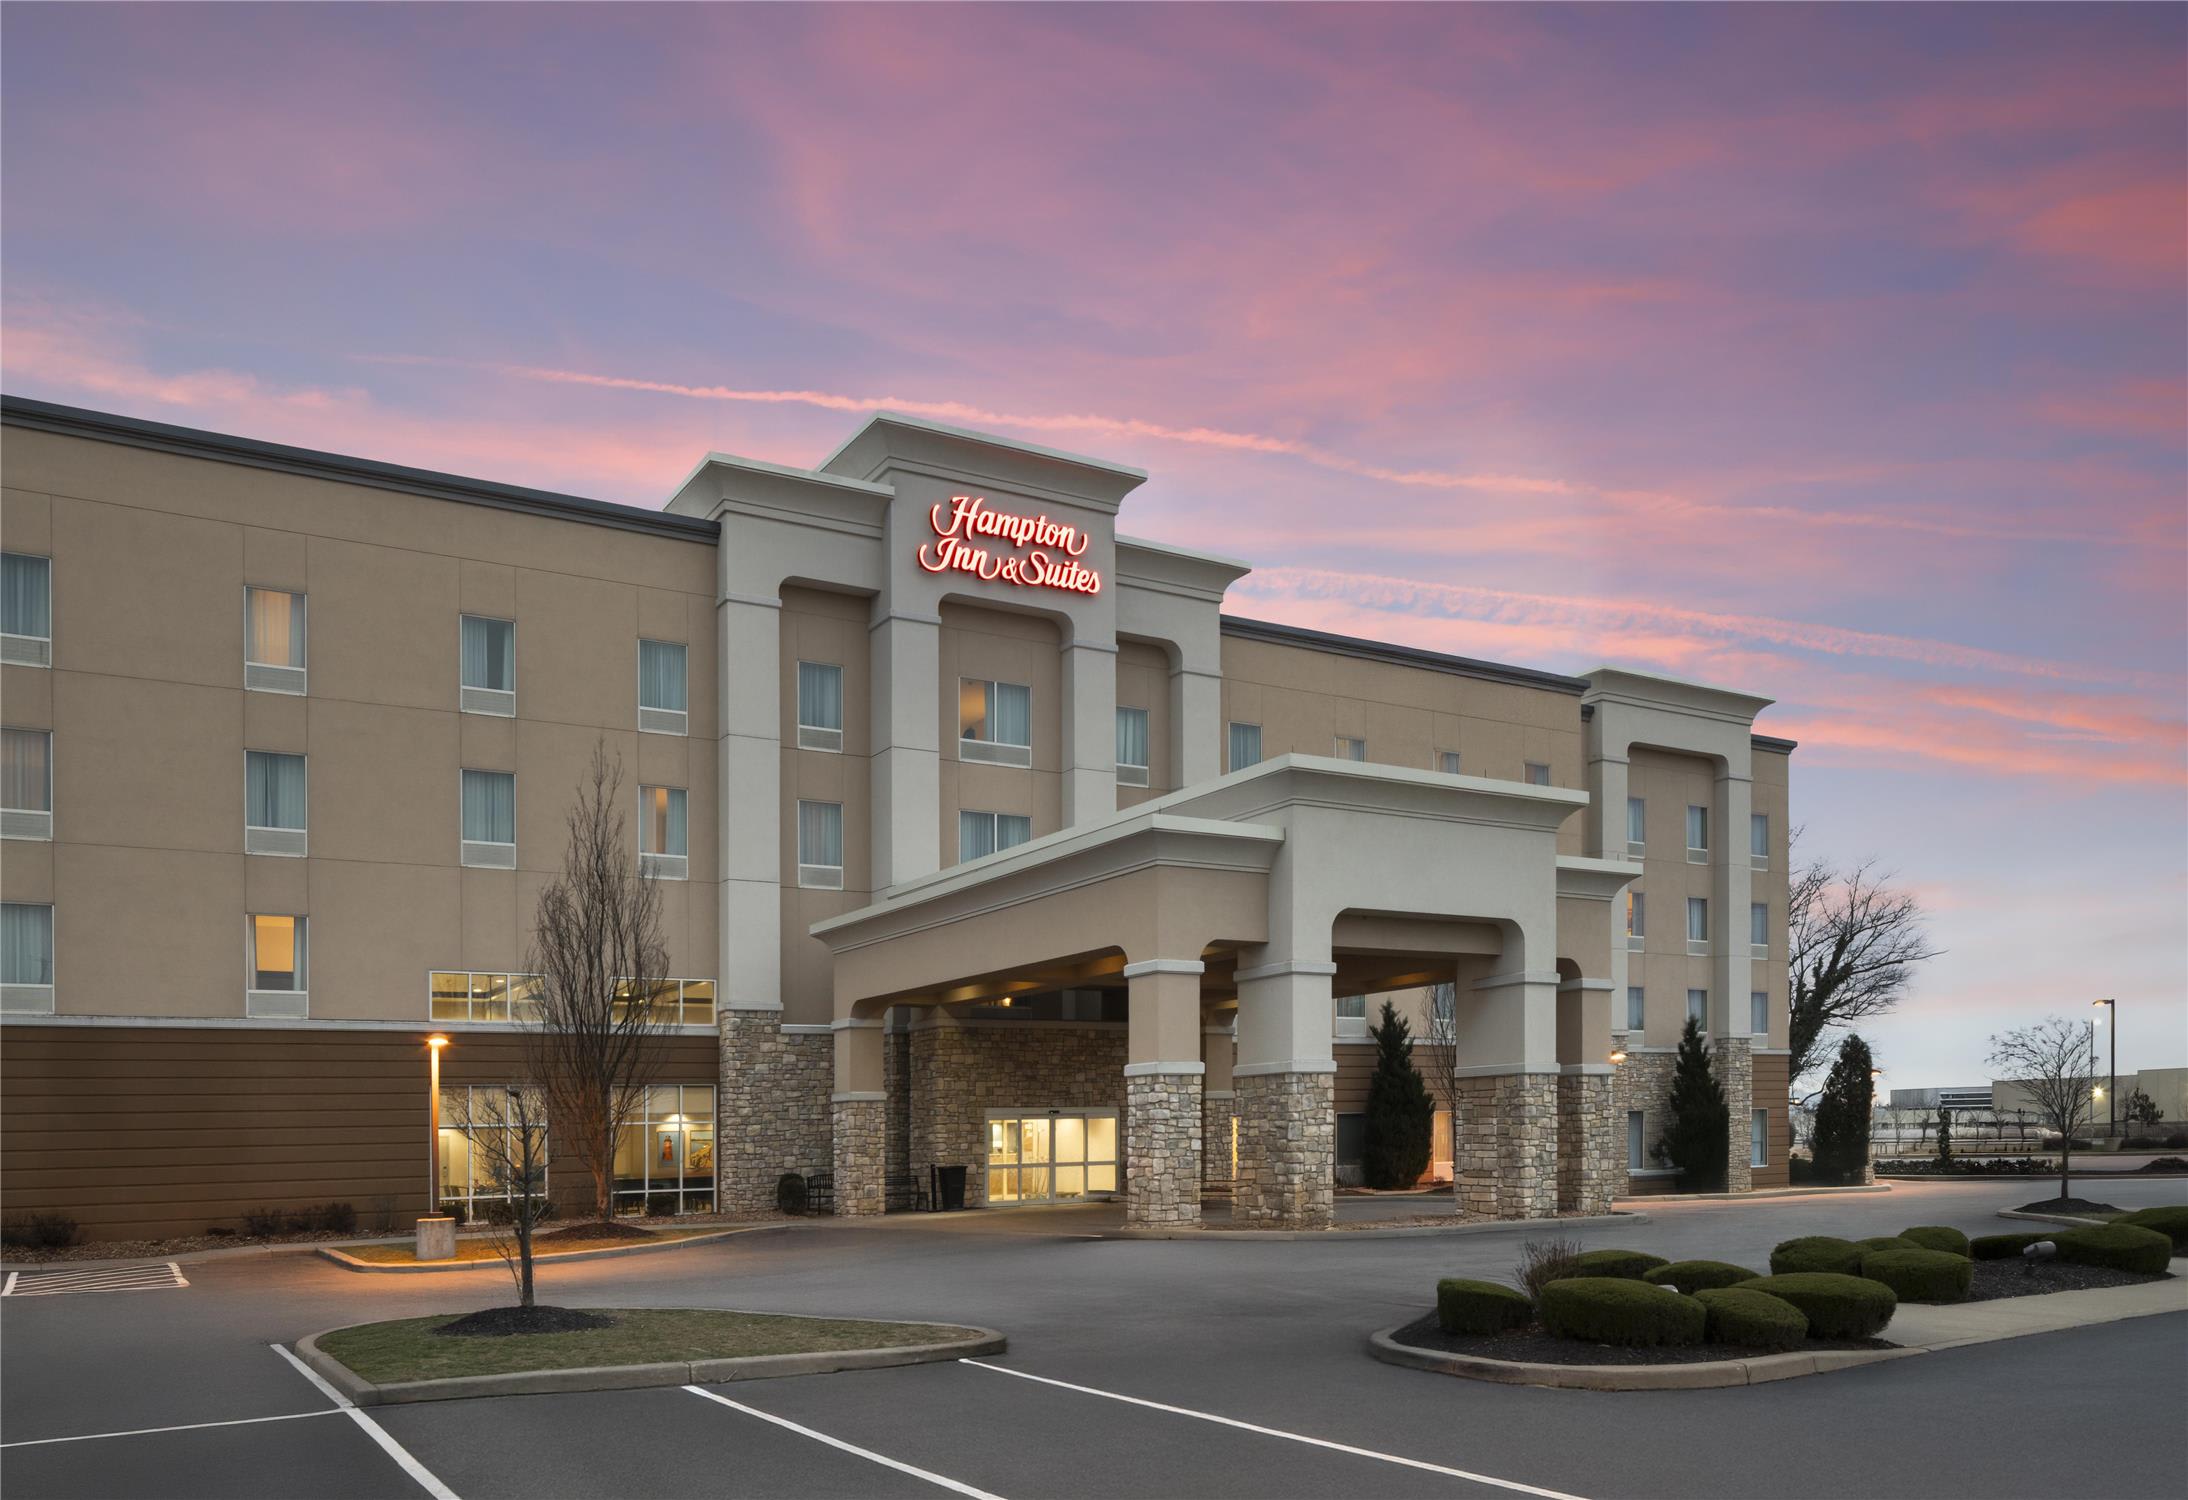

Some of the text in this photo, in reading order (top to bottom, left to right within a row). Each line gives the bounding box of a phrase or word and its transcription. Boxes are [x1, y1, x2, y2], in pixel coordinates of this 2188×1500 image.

[931, 496, 1088, 556] Hampton
[919, 538, 1001, 580] Inn
[1019, 551, 1101, 594] Suites
